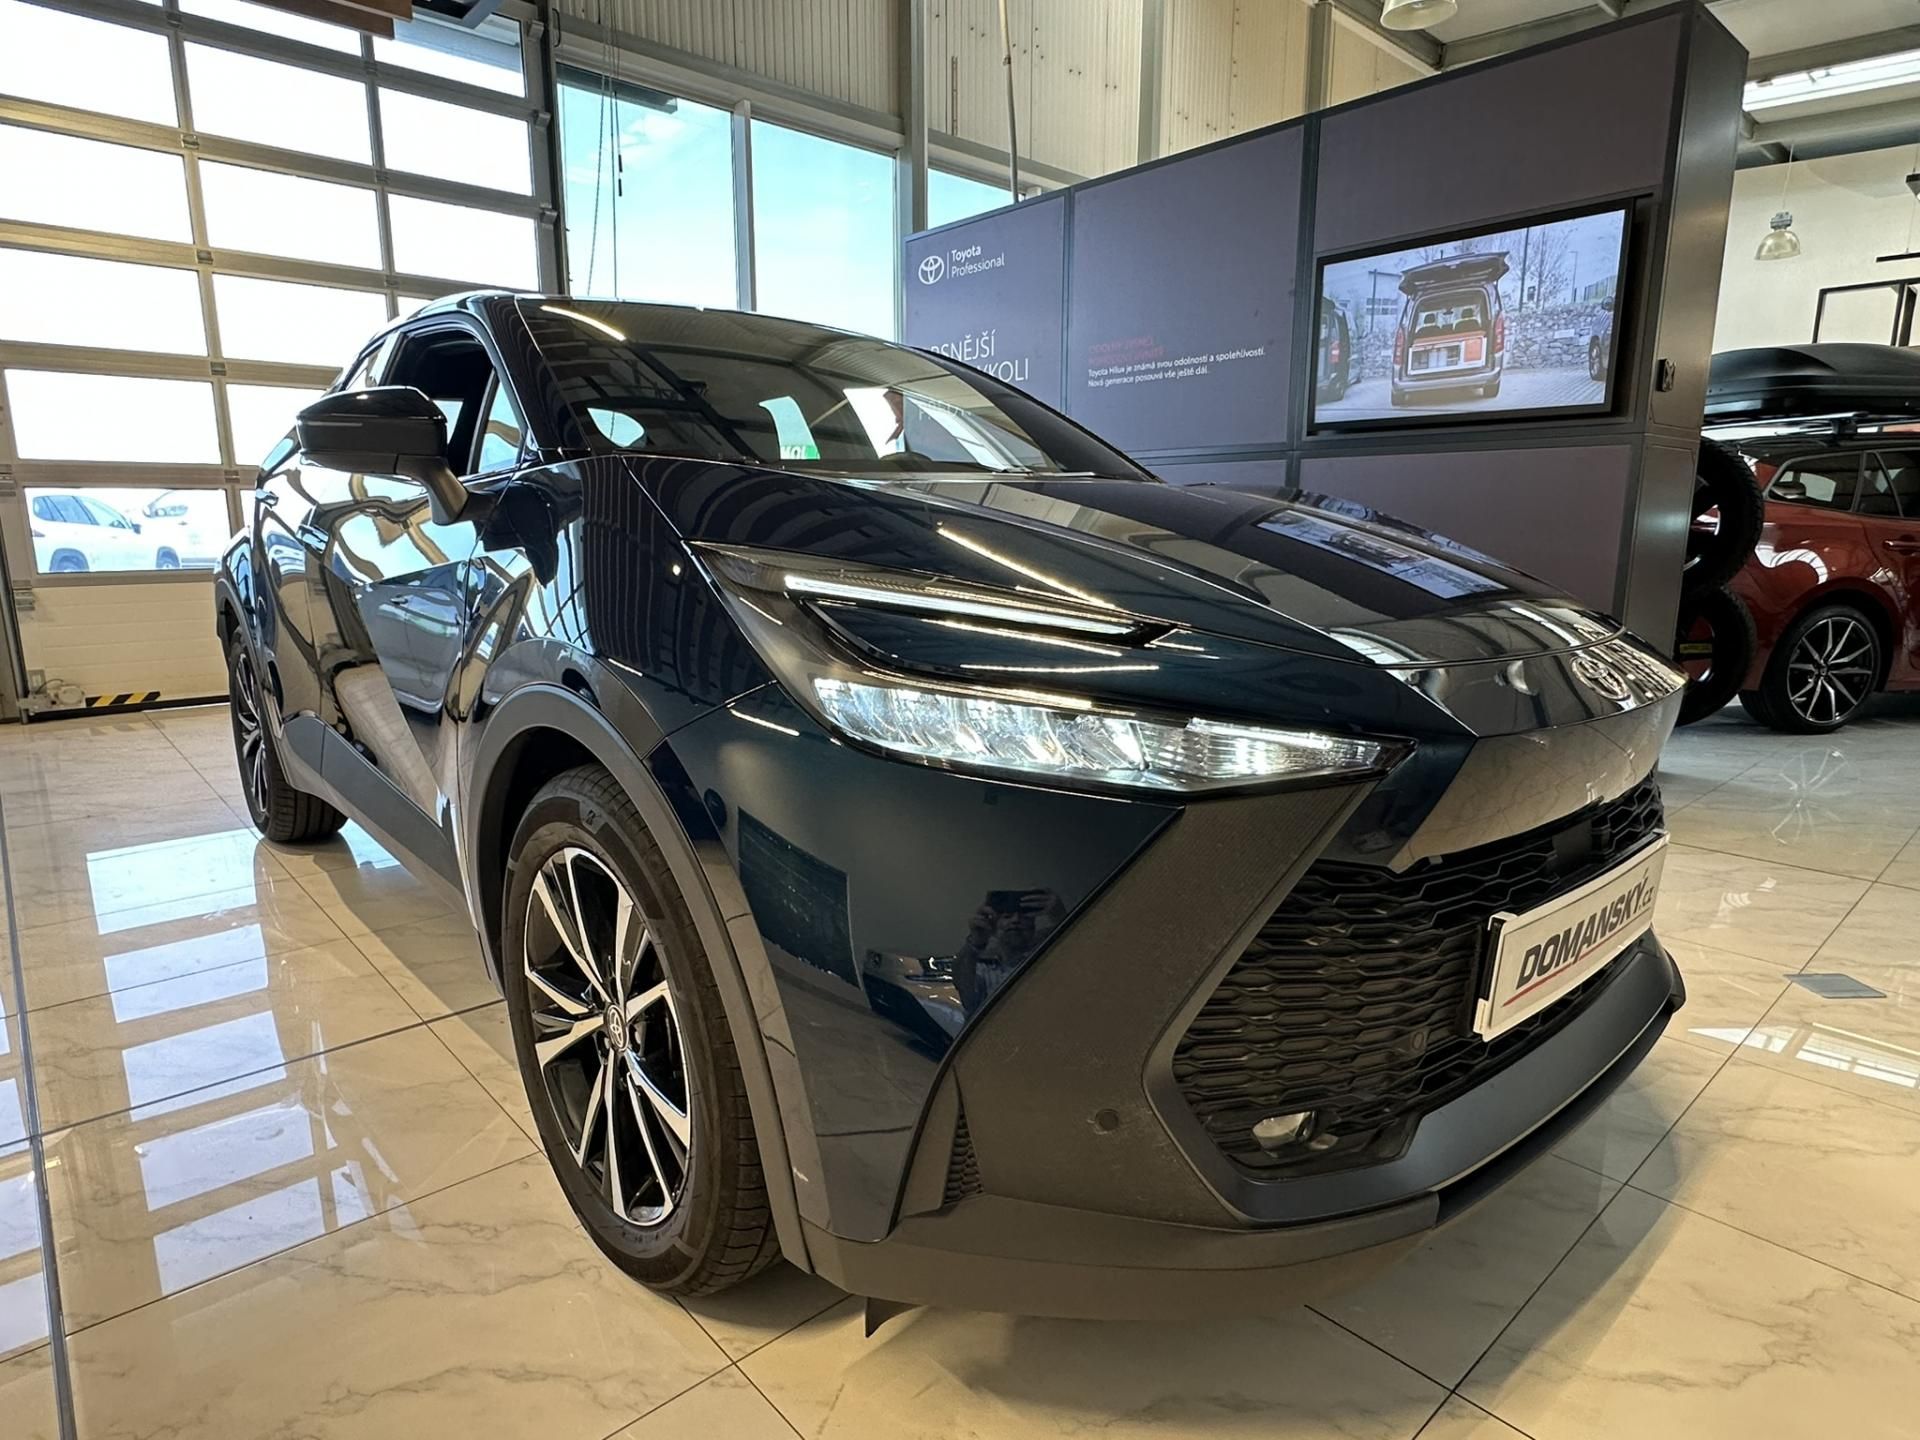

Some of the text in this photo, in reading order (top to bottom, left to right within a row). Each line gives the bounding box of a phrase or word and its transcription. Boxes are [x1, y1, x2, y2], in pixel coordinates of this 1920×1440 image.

[951, 245, 982, 262] Toyota
[951, 252, 1005, 278] Professional
[1088, 368, 1108, 379] Toyota
[1109, 365, 1125, 375] Hilux
[1126, 364, 1132, 375] je
[1157, 360, 1173, 369] svou
[1209, 354, 1214, 362] a
[1088, 378, 1104, 388] Nová
[1105, 376, 1134, 388] generace
[1135, 371, 1163, 384] posouvá
[1164, 369, 1176, 379] vše
[1177, 366, 1194, 380] ještě
